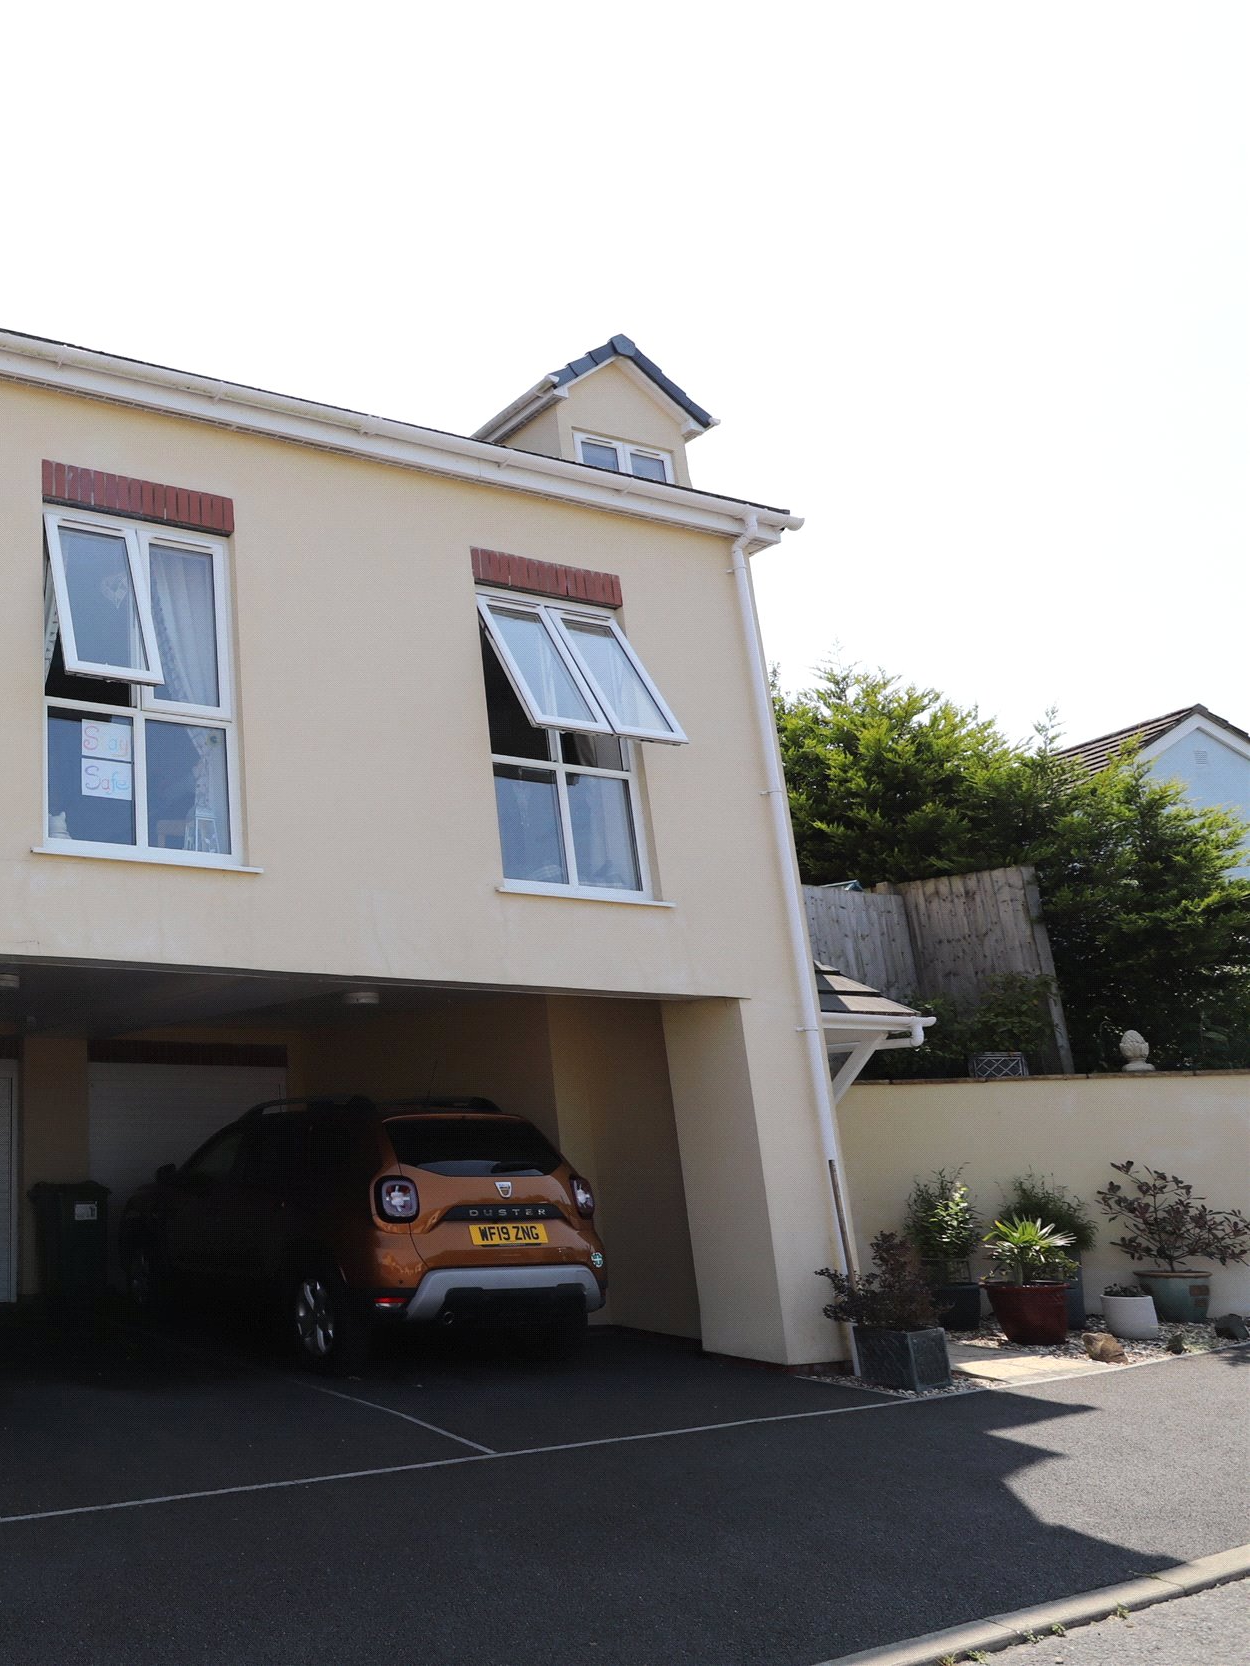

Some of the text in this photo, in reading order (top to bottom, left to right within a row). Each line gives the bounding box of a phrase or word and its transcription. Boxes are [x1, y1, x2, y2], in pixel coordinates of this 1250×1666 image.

[83, 725, 129, 757] Say
[84, 765, 130, 793] Safe
[469, 1209, 547, 1217] DUSTER
[478, 1225, 540, 1242] WF19 ZNG
